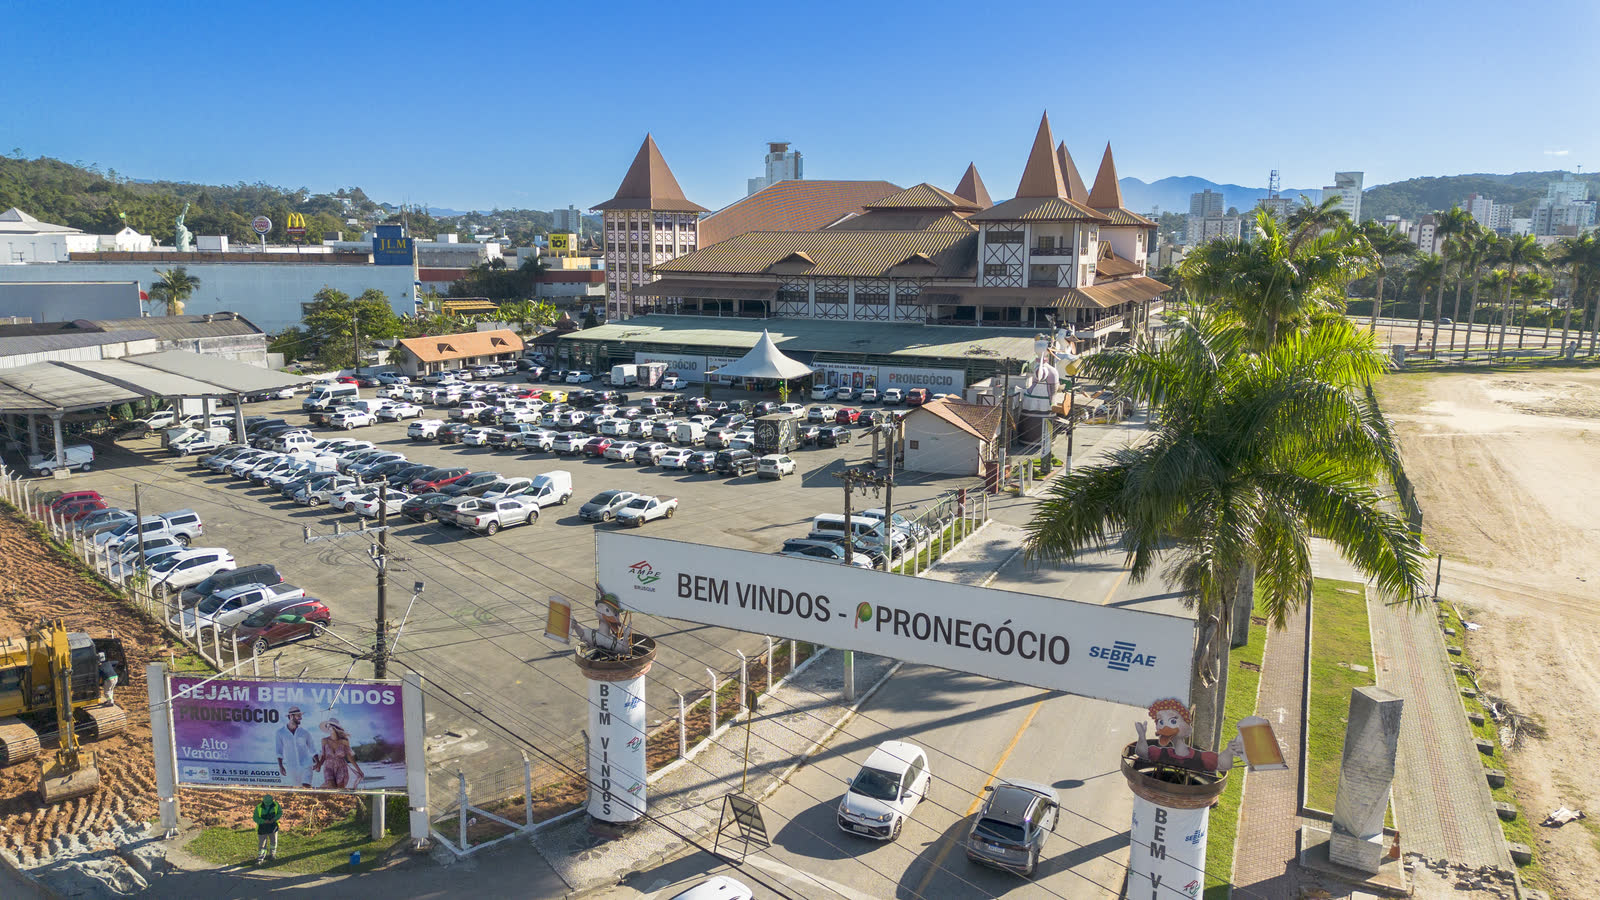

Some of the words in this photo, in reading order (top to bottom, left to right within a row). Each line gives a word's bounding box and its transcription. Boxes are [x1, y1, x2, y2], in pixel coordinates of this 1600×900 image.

[551, 239, 567, 248] 10!
[889, 372, 953, 386] PRONEGÓCIO
[677, 572, 729, 605] BEM
[735, 581, 831, 623] VINDOS
[875, 604, 1071, 666] PRONEGÓCIO
[1088, 644, 1157, 668] SEBRAE
[178, 683, 250, 701] SEJAM
[257, 686, 306, 703] BEM
[312, 688, 396, 705] VINDOS
[599, 683, 611, 726] BEM
[179, 704, 280, 724] PRONEGÓCIO
[181, 746, 220, 760] Verão
[200, 738, 228, 750] Alto
[1150, 807, 1168, 861] BEM
